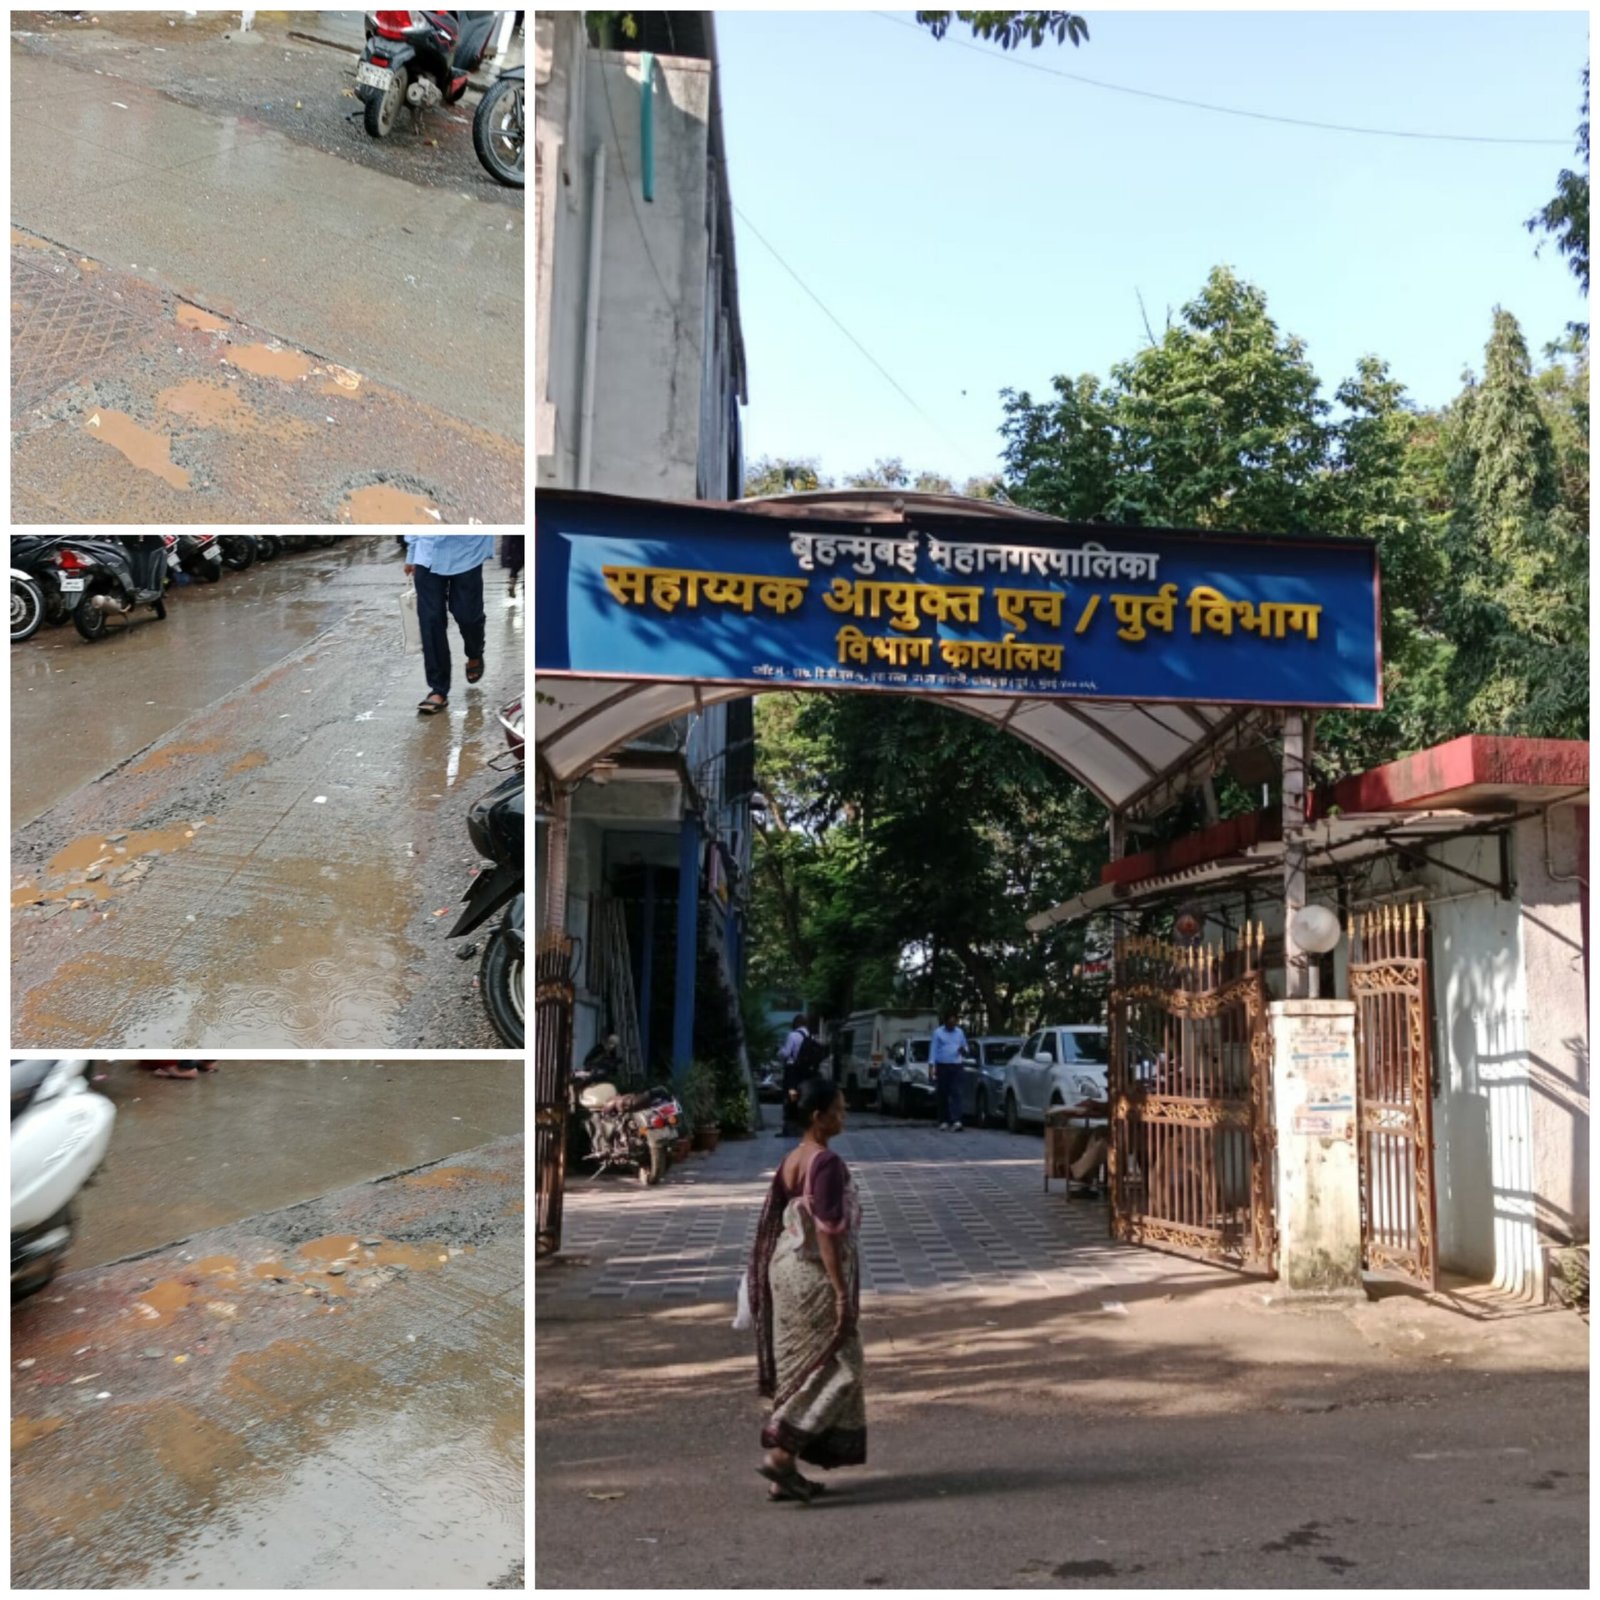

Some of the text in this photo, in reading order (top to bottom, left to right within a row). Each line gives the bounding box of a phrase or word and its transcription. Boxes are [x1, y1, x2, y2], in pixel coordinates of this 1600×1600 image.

[789, 527, 1160, 581] बृहन्मुंबई महानगरपालिका
[602, 565, 808, 613] सहाय्यक
[821, 577, 983, 630] आयुक्त
[994, 586, 1067, 633] एच
[1186, 586, 1322, 640] विभाग
[836, 624, 1064, 672] विभाग कार्यालय
